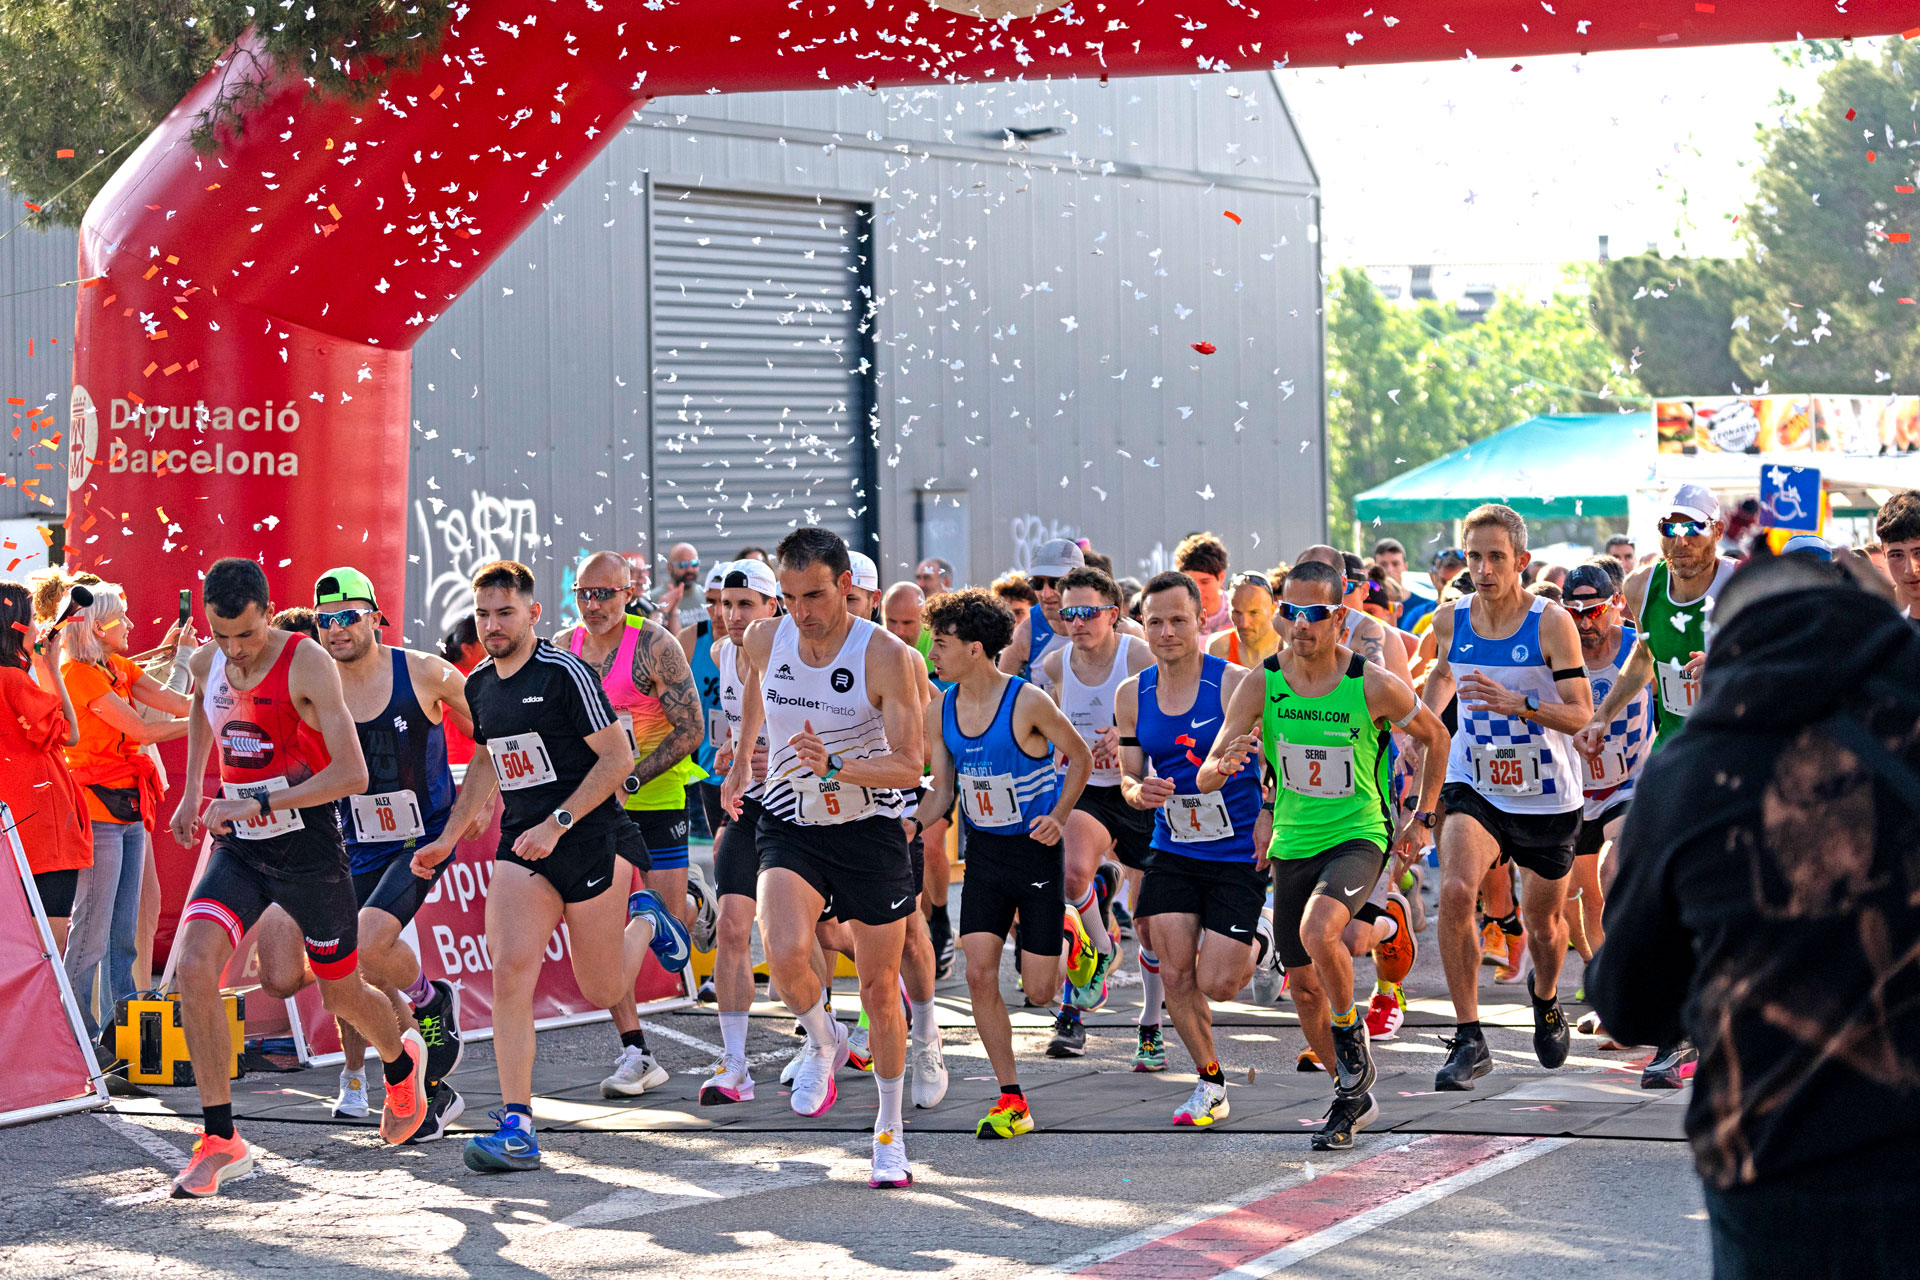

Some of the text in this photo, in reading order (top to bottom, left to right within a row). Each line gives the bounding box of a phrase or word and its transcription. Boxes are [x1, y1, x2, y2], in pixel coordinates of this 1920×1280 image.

[110, 398, 300, 436] Diputació
[109, 443, 299, 476] Barcelona
[522, 696, 543, 704] adidas
[1277, 707, 1350, 724] LASANSI.COM
[505, 740, 520, 752] XAVI
[1305, 749, 1327, 760] SERGI
[1495, 748, 1516, 759] JORDI
[501, 750, 535, 780] 504
[1309, 761, 1322, 787] 2
[1489, 760, 1523, 786] 325
[1588, 757, 1606, 780] 19
[818, 780, 841, 793] CHÚS
[972, 780, 993, 791] DANIEL
[374, 796, 392, 807] ALEX
[823, 793, 841, 816] 5
[975, 791, 994, 816] 14
[1181, 796, 1202, 809] RUBÉN
[375, 807, 397, 832] 18
[1190, 808, 1201, 831] 4
